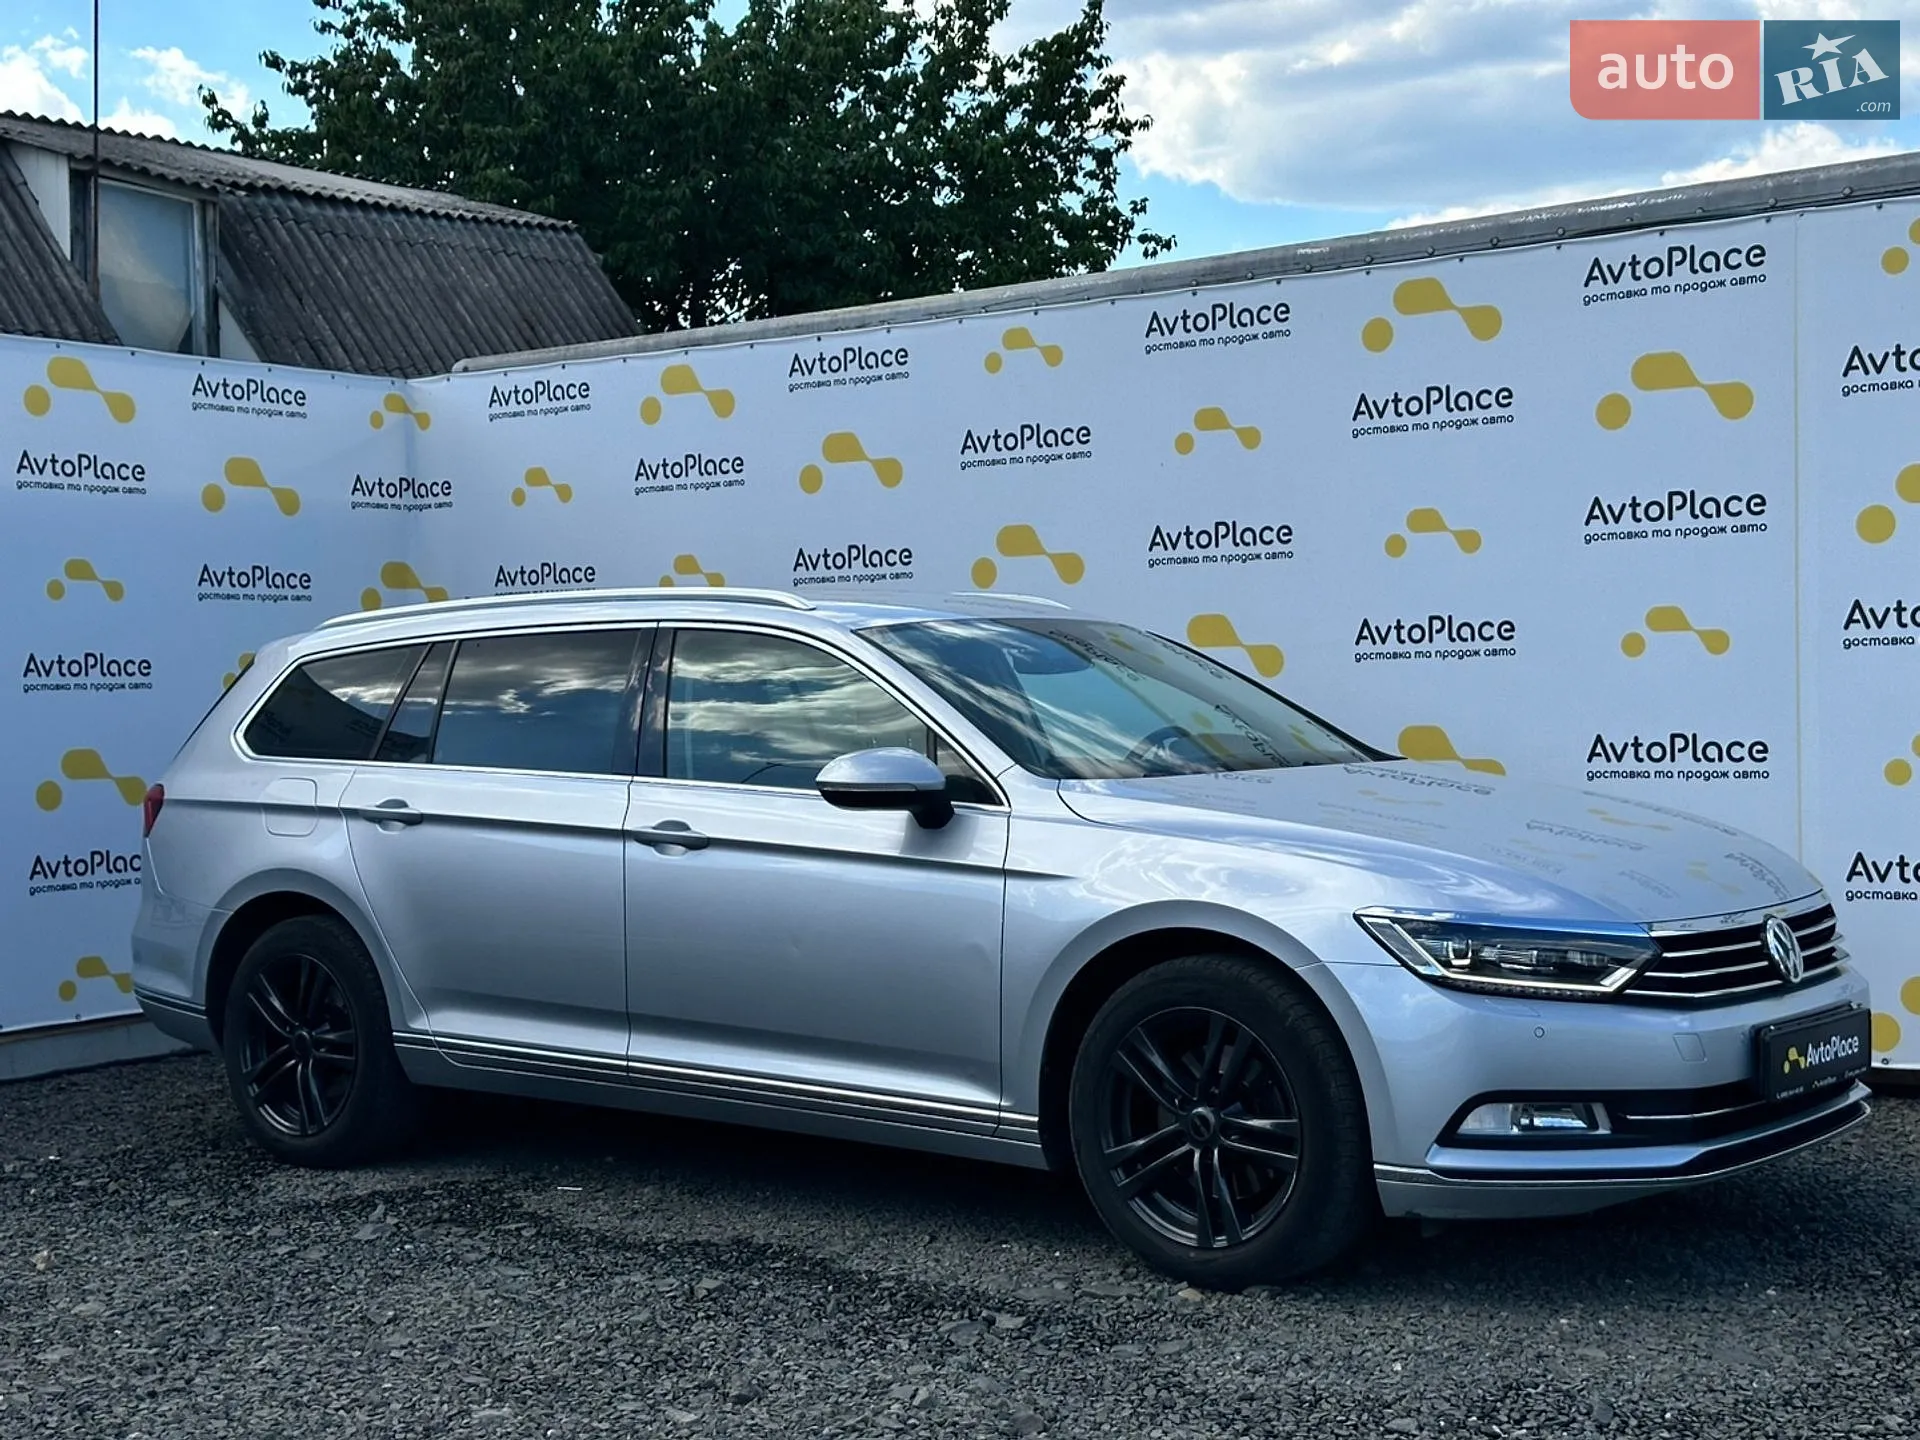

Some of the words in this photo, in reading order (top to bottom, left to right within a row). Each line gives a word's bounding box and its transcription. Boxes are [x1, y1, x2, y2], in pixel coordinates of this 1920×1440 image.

[1583, 243, 1766, 287] AvtoPlace
[1583, 288, 1647, 306] доставка
[1651, 285, 1670, 295] та
[1674, 279, 1726, 294] продаж
[1730, 274, 1766, 286] авто
[1146, 301, 1290, 338] AvtoPlace
[789, 345, 909, 378] AvtoPlace
[192, 373, 306, 407] AvtoPlace
[489, 380, 591, 408] AvtoPlace
[1352, 384, 1513, 422] AvtoPlace
[1841, 380, 1914, 397] доставка
[960, 423, 1091, 455] AvtoPlace
[1352, 424, 1409, 438] доставка
[1412, 422, 1429, 431] та
[1432, 418, 1478, 431] продаж
[1482, 415, 1514, 425] авто
[16, 450, 145, 482] AvtoPlace
[635, 453, 744, 482] AvtoPlace
[351, 474, 452, 498] AvtoPlace
[1584, 490, 1767, 526] AvtoPlace
[1148, 520, 1293, 552] AvtoPlace
[1584, 530, 1648, 545] доставка
[1652, 529, 1671, 538] та
[1675, 525, 1727, 539] продаж
[1731, 523, 1767, 533] авто
[793, 544, 913, 572] AvtoPlace
[198, 564, 311, 590] AvtoPlace
[495, 562, 596, 587] AvtoPlace
[1355, 615, 1515, 646] AvtoPlace
[1843, 636, 1915, 650] доставка
[23, 652, 152, 678] AvtoPlace
[1355, 651, 1411, 663] доставка
[1414, 651, 1432, 659] та
[1435, 649, 1481, 661] продаж
[1483, 648, 1516, 657] авто
[1587, 733, 1769, 763] AvtoPlace
[1587, 770, 1651, 782] доставка
[1654, 770, 1674, 779] та
[1678, 770, 1729, 782] продаж
[1733, 770, 1769, 779] авто
[29, 849, 141, 881] AvtoPlac
[1845, 890, 1918, 902] доставка
[1806, 1035, 1859, 1067] AvtoPlace
